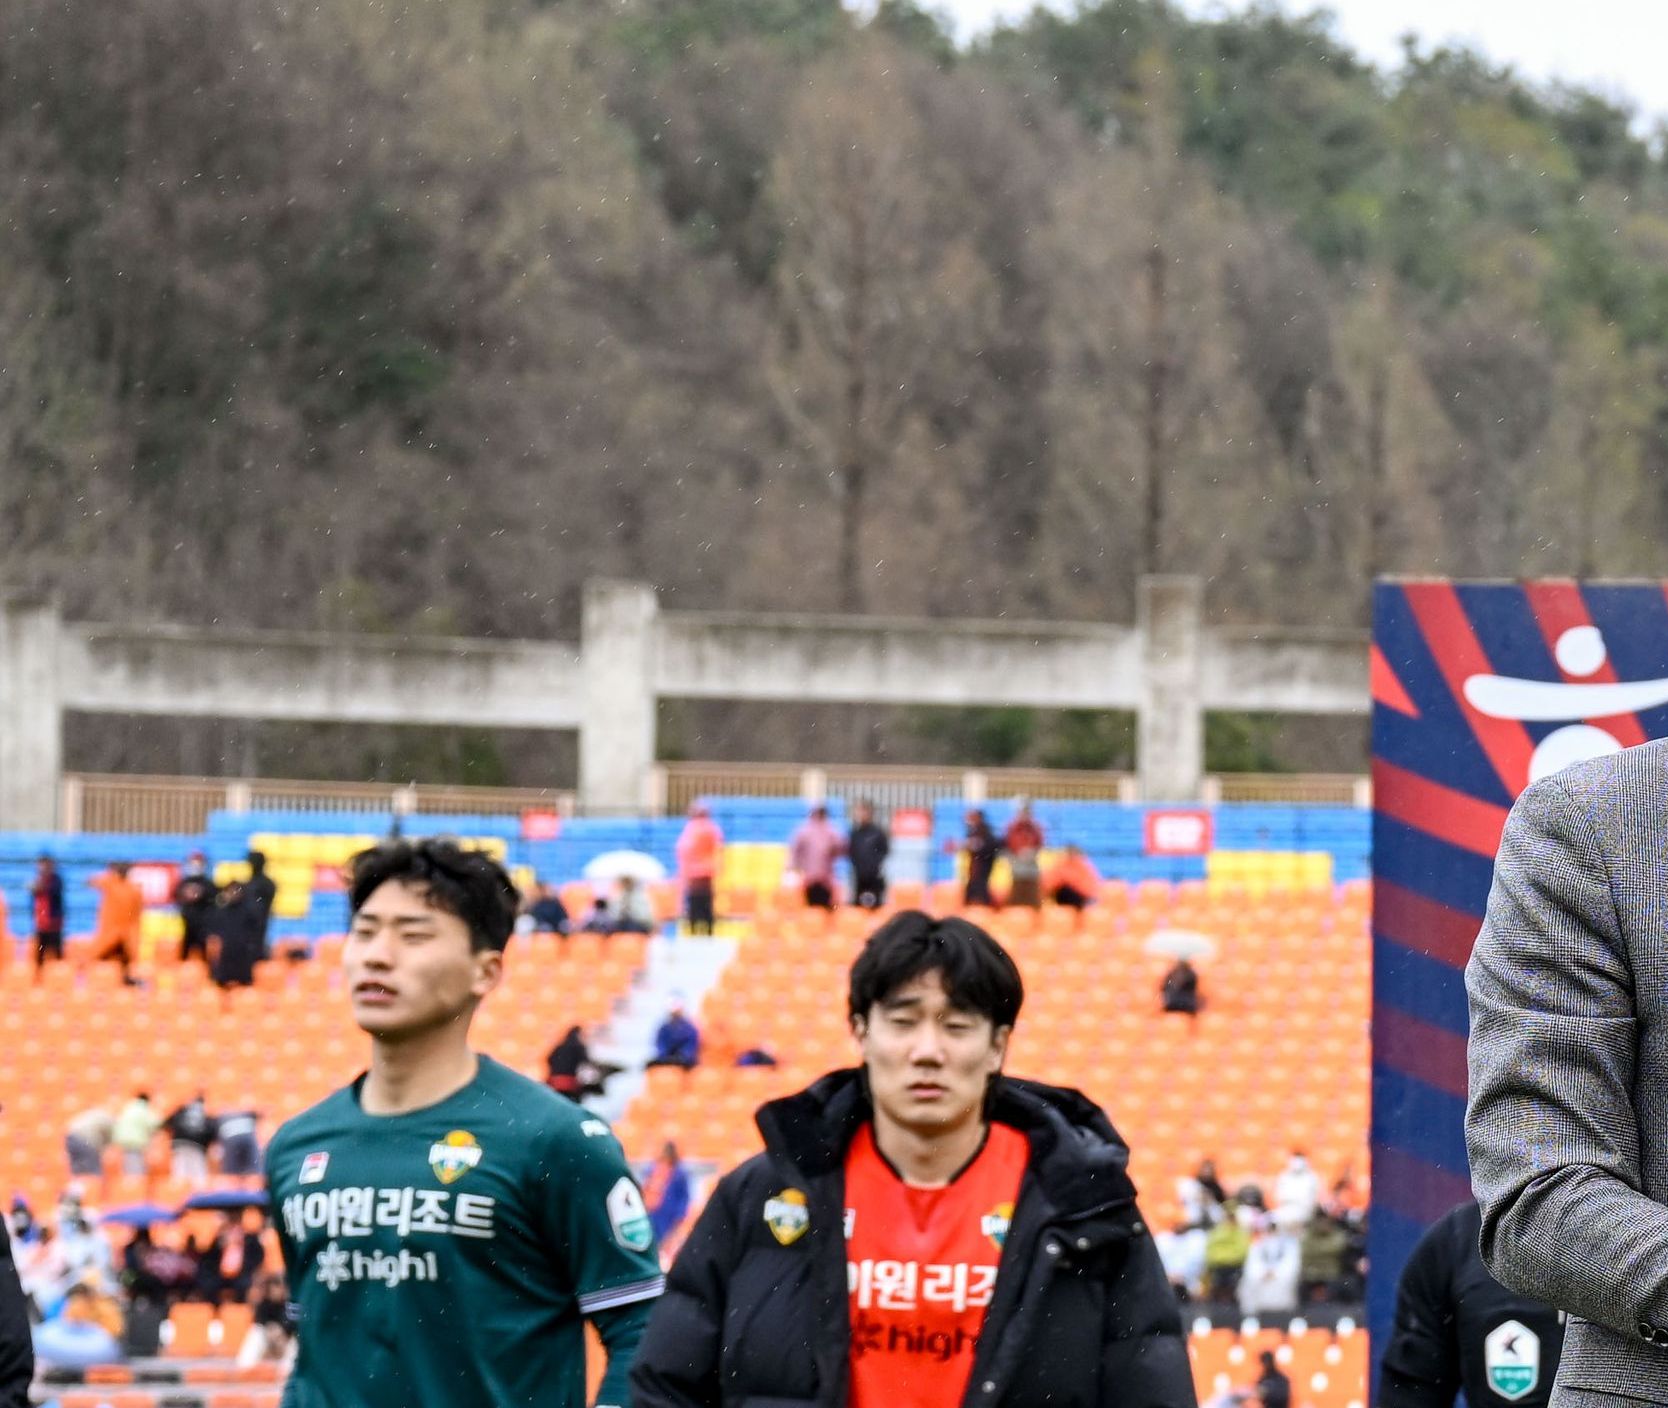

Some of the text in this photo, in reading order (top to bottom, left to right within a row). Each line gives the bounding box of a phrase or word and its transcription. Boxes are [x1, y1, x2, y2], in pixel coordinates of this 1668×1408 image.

[352, 1249, 438, 1288] high1
[847, 1259, 998, 1312] 이원리조
[888, 1322, 981, 1360] high
